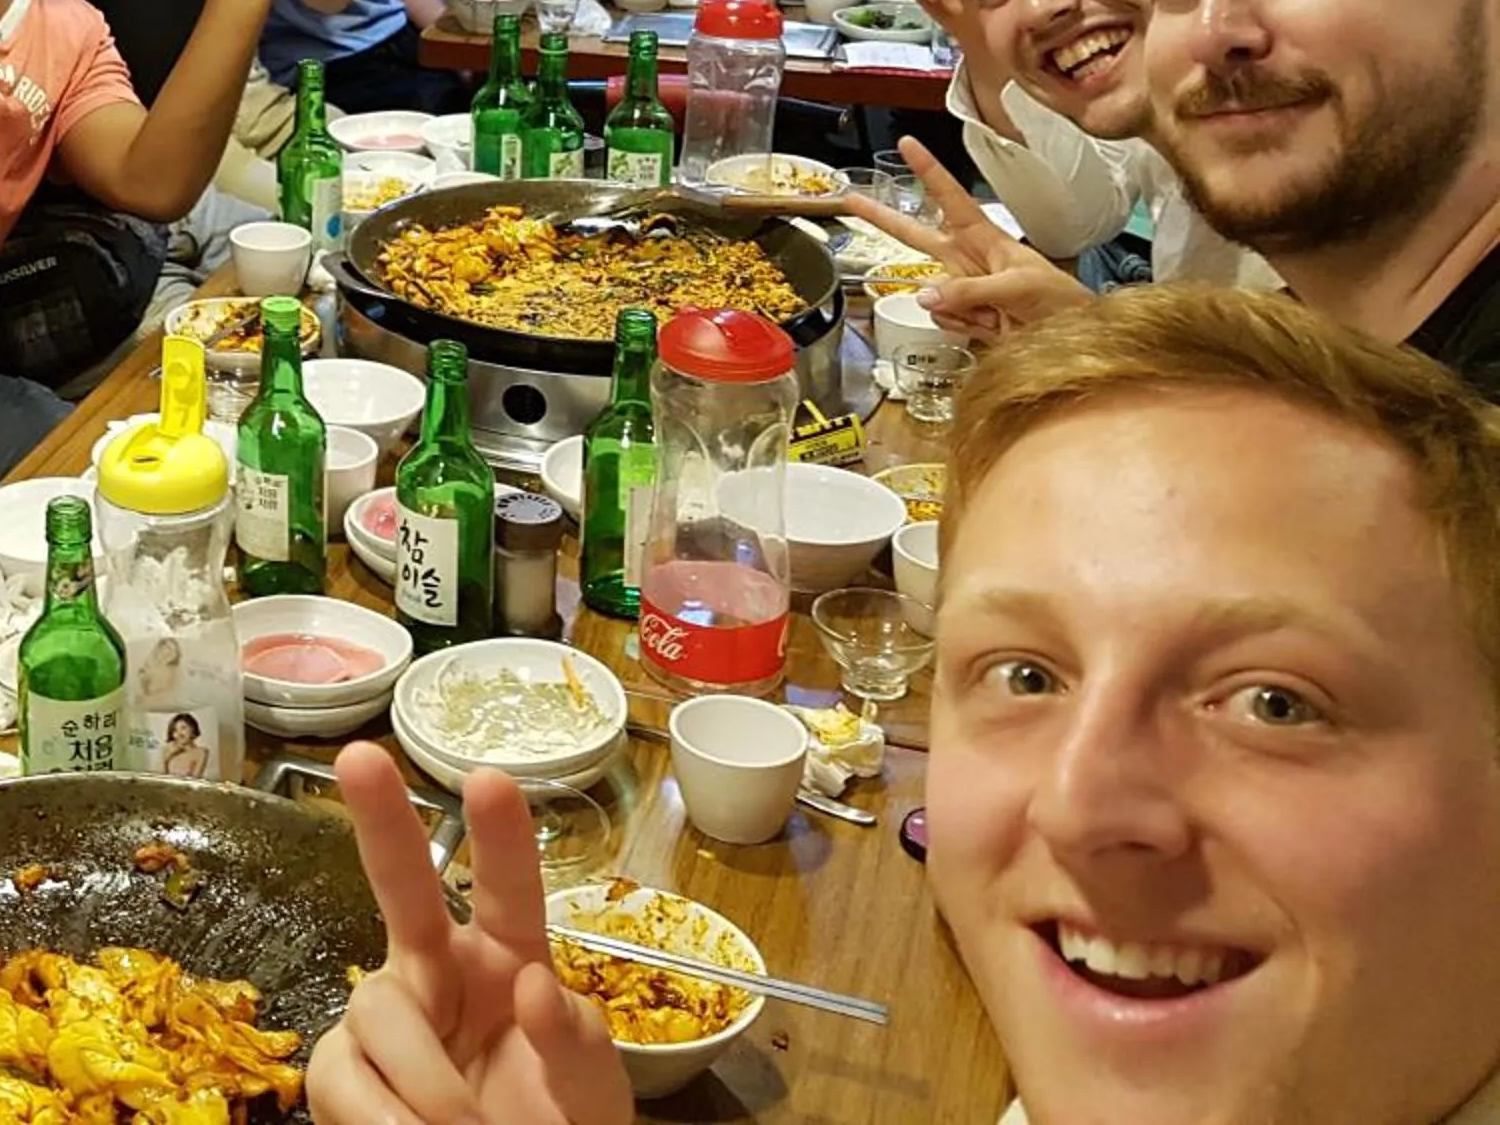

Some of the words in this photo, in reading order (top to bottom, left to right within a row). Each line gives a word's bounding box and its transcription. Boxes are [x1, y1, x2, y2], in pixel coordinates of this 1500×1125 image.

[402, 563, 442, 608] 이슬
[60, 710, 118, 738] 순하리
[68, 734, 114, 763] 처음
